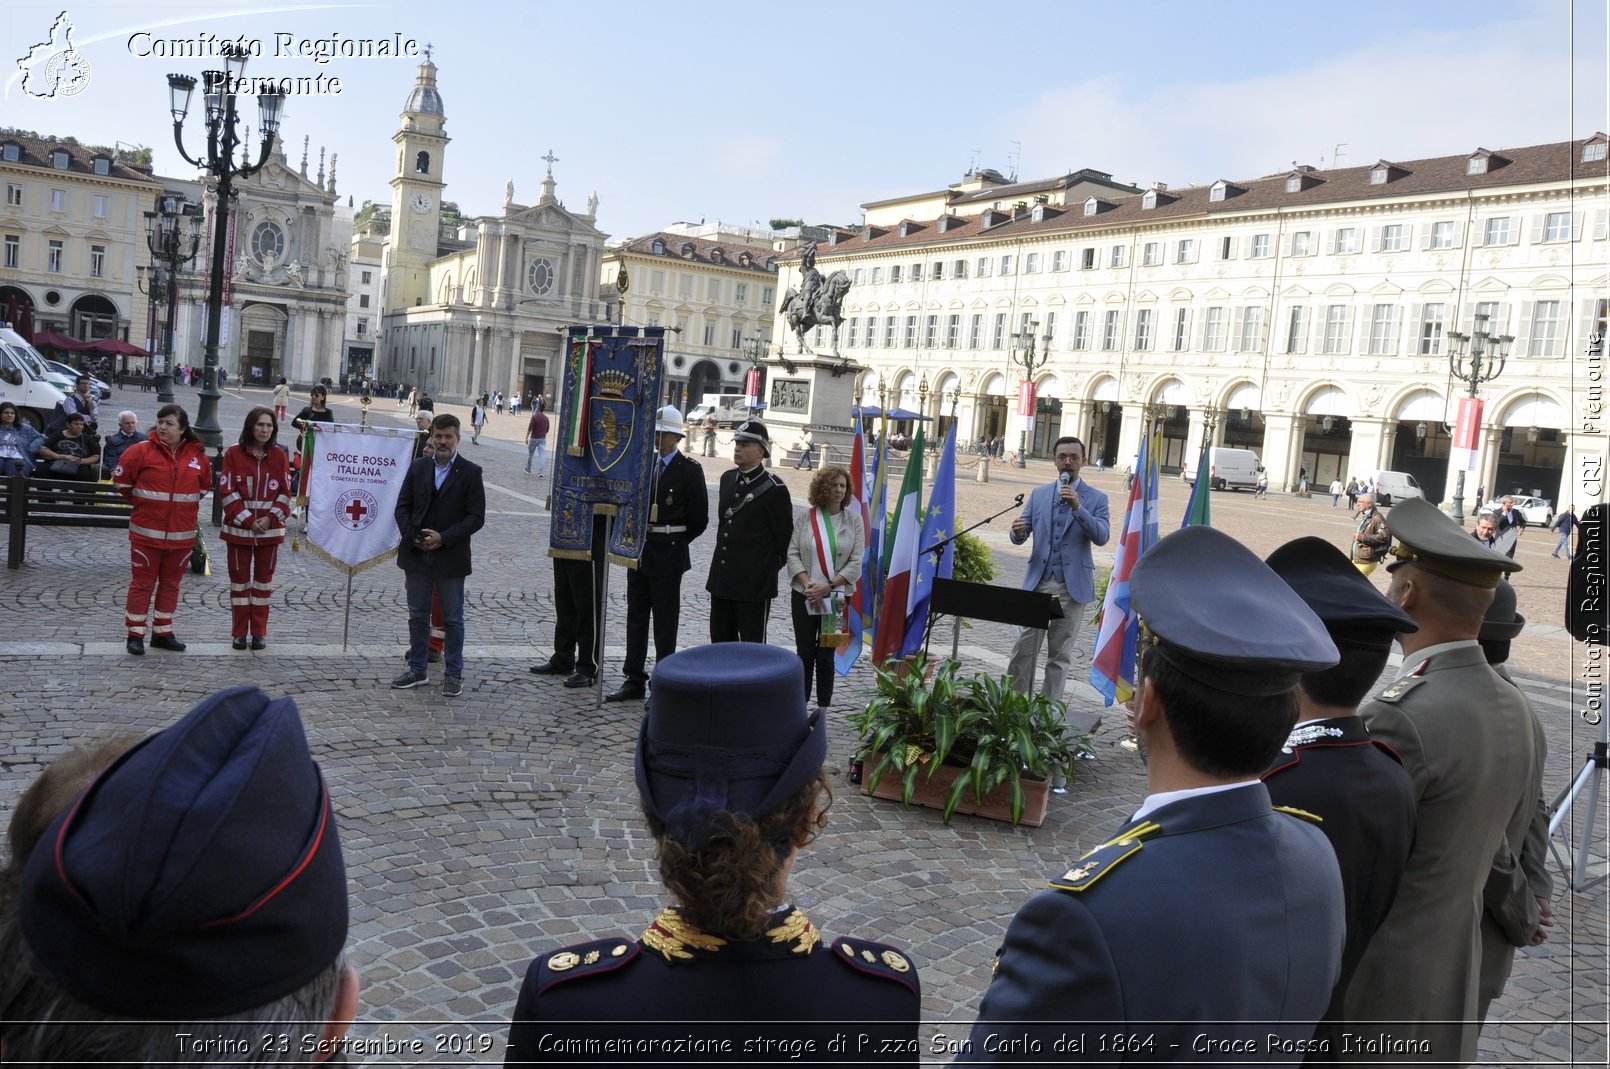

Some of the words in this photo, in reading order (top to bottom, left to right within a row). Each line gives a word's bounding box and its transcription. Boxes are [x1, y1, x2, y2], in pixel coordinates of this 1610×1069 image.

[327, 453, 358, 463] CROCE
[363, 457, 396, 467] ROSSA
[337, 465, 381, 477] ITALIANA
